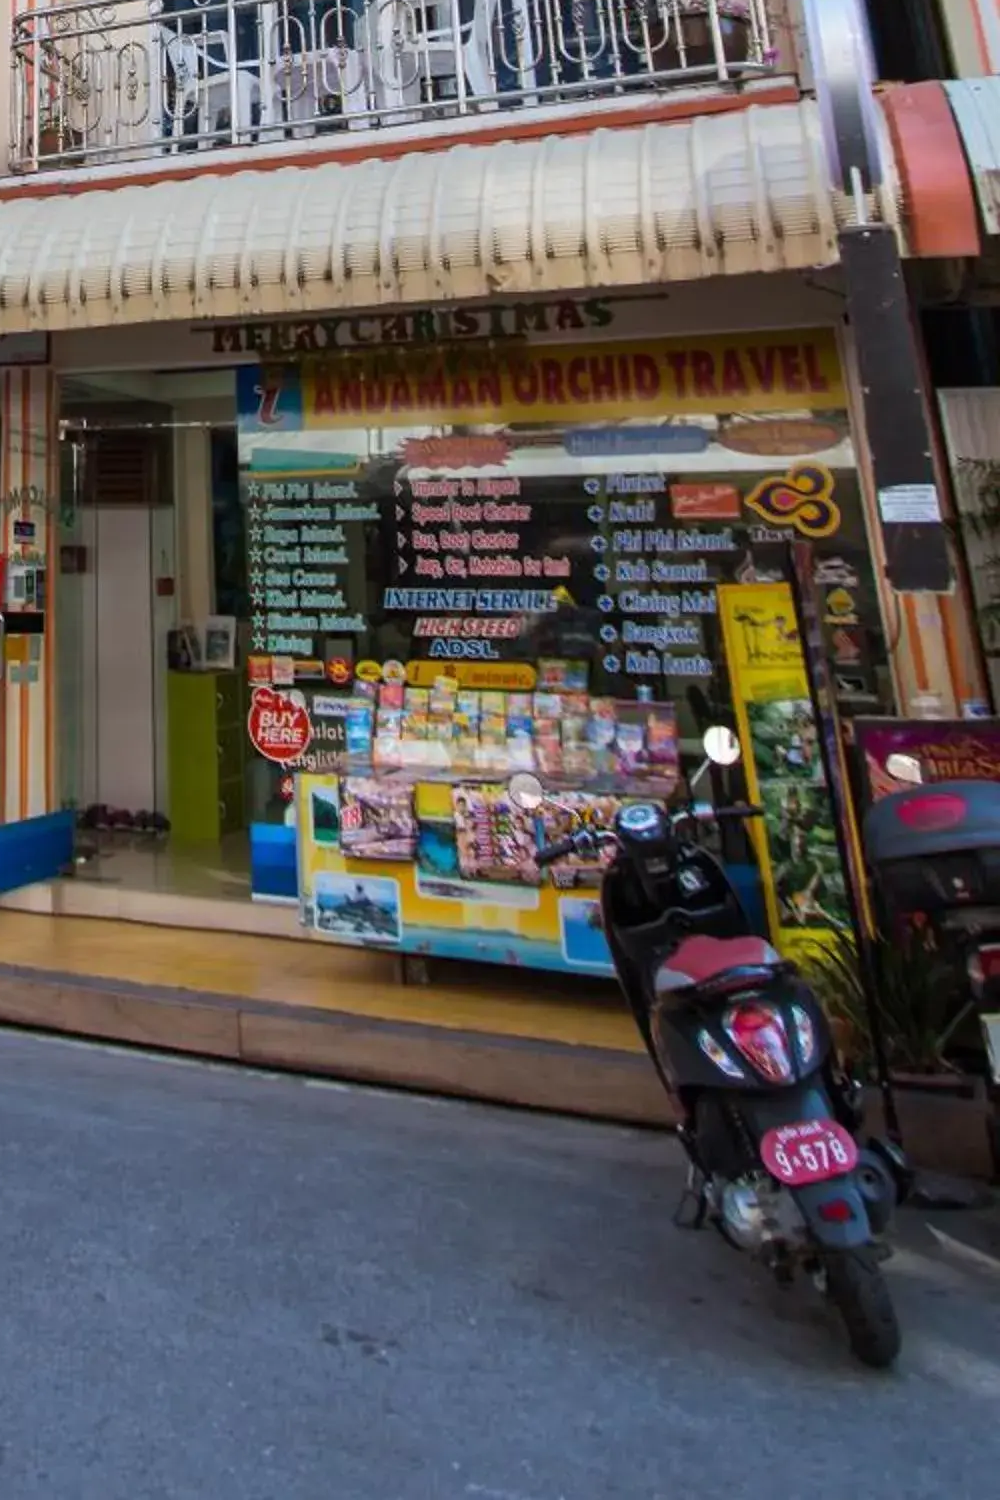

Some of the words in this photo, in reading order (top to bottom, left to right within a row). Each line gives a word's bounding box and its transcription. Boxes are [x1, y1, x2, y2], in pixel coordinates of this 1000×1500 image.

[212, 320, 341, 353] MERRY
[350, 297, 615, 343] CHRISTMAS
[312, 366, 502, 417] ANDAMAN
[510, 352, 661, 406] ORCHID
[670, 343, 827, 398] TRAVEL
[605, 473, 665, 493] Phuket
[608, 501, 655, 522] Krabi
[612, 529, 642, 551] Phi
[644, 529, 674, 551] Phi
[383, 587, 474, 611] INTERNET
[475, 588, 559, 613] SERVICE
[413, 617, 461, 637] HIGH
[462, 618, 523, 639] SPEED
[622, 620, 698, 650] Bangkok
[429, 638, 500, 659] ADSL
[259, 711, 301, 727] BUY
[257, 726, 305, 744] HERE
